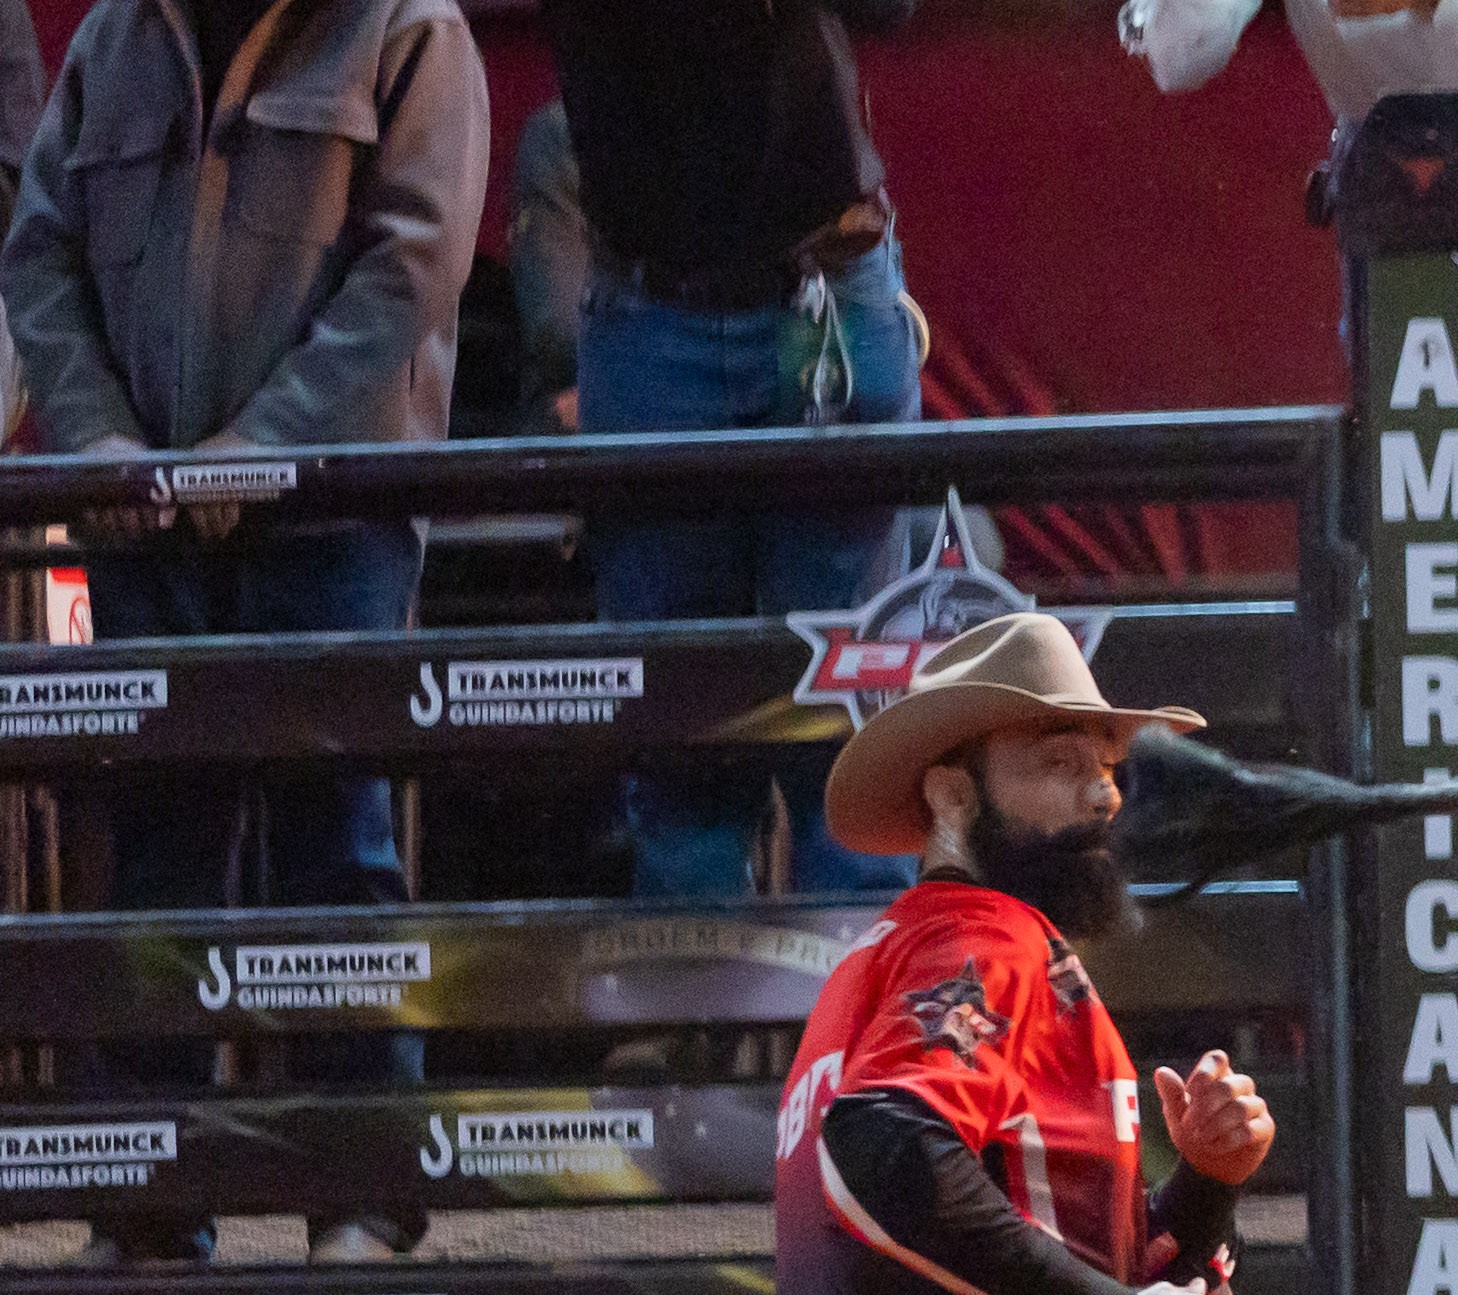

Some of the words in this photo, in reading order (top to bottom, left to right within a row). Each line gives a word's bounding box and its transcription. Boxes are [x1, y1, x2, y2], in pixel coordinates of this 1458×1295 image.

[458, 669, 631, 693] TRANSMUNCK
[246, 953, 418, 976] TRANSMUNCK
[468, 1119, 641, 1142] TRANSMUNCK
